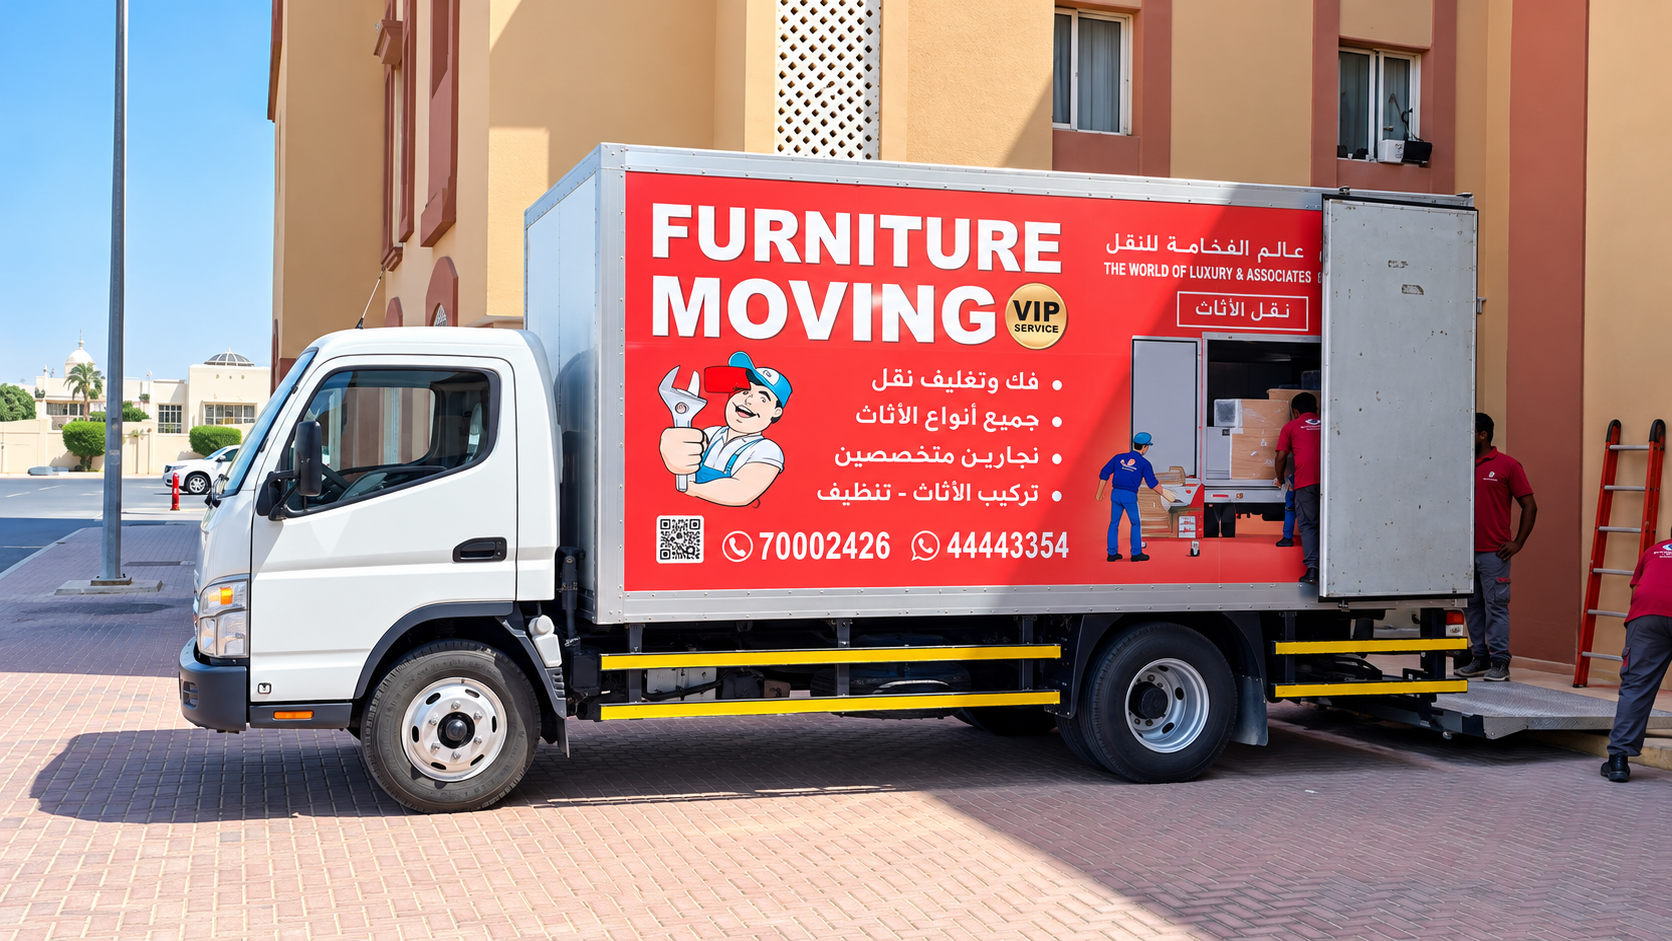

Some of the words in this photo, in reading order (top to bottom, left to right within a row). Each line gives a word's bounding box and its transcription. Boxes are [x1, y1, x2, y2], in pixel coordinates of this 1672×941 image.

[652, 202, 1062, 274] FURNITURE
[1105, 232, 1159, 255] للنقل
[1166, 235, 1249, 257] الفخامة
[1257, 241, 1304, 264] عالم
[1103, 262, 1127, 276] THE
[1129, 262, 1169, 278] WORLD
[1172, 264, 1187, 279] OF
[1189, 265, 1233, 281] LUXURY
[1235, 267, 1244, 281] &
[1246, 268, 1312, 284] ASSOCIATES
[652, 275, 997, 345] MOVING
[1012, 299, 1061, 322] VIP
[1195, 297, 1245, 317] الأثاث
[1250, 301, 1290, 322] نقل
[1013, 323, 1060, 335] SERVICE
[871, 367, 914, 392] نقل
[920, 369, 999, 395] وتغليف
[1005, 371, 1040, 391] فك
[855, 402, 918, 426] الأثاث
[924, 402, 977, 432] أنواع
[983, 411, 1040, 433] جميع
[834, 445, 955, 468] متخصصين
[961, 445, 1039, 469] نجارين
[816, 482, 892, 507] تنظيف
[912, 480, 971, 503] الأثاث
[977, 483, 1039, 508] تركيب
[759, 531, 891, 561] 70002426
[946, 531, 1069, 560] 44443354
